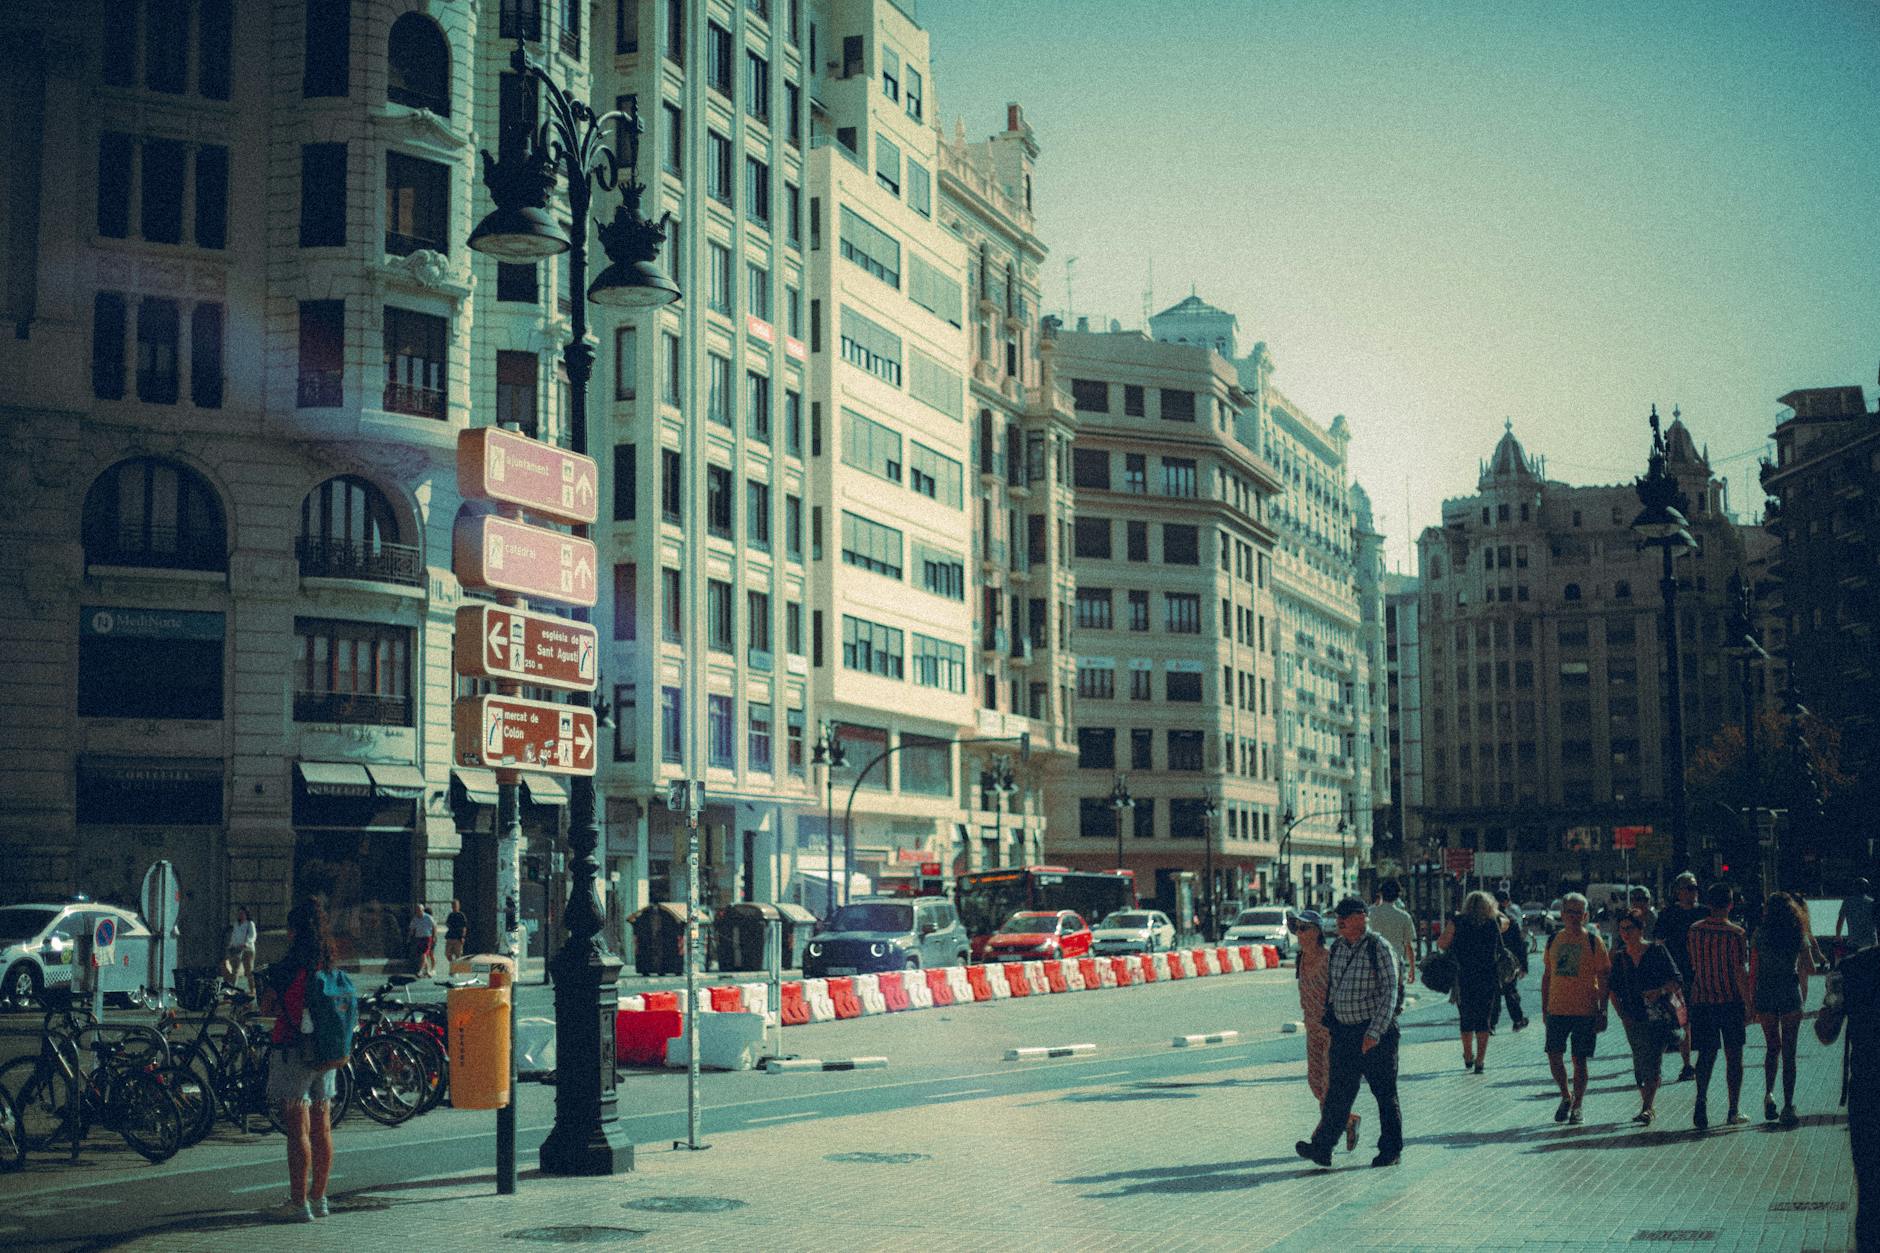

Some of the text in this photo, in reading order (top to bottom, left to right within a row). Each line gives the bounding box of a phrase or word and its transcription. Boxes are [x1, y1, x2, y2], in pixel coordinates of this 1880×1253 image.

[505, 453, 550, 477] ajuntament
[505, 543, 536, 561] catedral
[541, 630, 579, 645] església de
[537, 643, 579, 663] Sant Agustí
[525, 659, 536, 669] 250
[504, 711, 539, 724] mercat de
[503, 726, 525, 739] Colón
